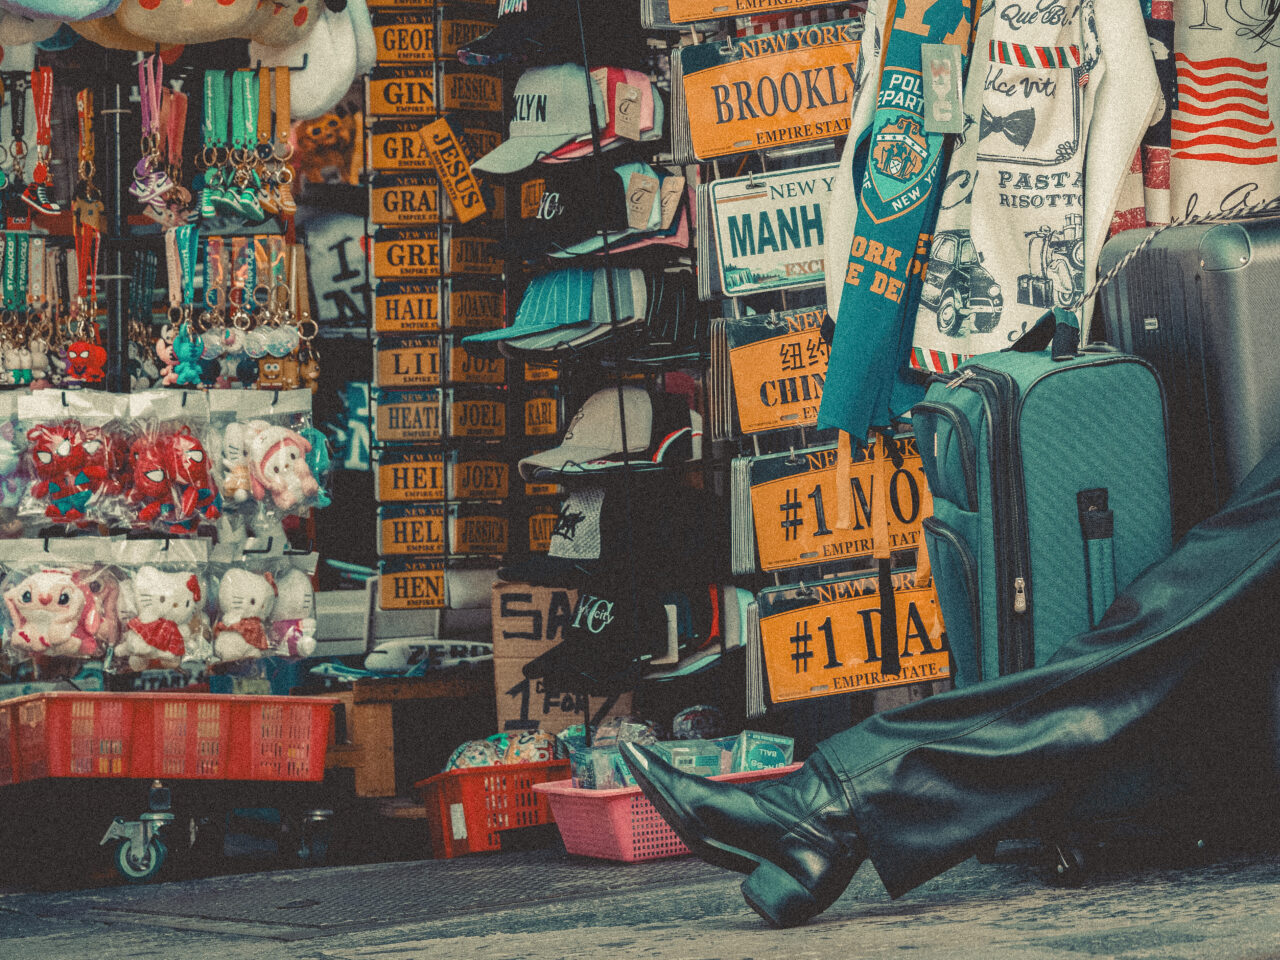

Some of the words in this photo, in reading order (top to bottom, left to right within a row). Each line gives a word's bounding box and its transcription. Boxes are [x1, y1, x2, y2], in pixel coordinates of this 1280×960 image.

[1000, 3, 1039, 31] Que
[739, 34, 789, 60] NEW
[792, 24, 850, 51] YORK
[756, 125, 813, 145] EMPIRE
[770, 177, 816, 201] NEW
[891, 186, 921, 212] NEW
[7, 240, 15, 291] STARBUCKS
[780, 484, 833, 541] #1
[790, 616, 843, 674] #1
